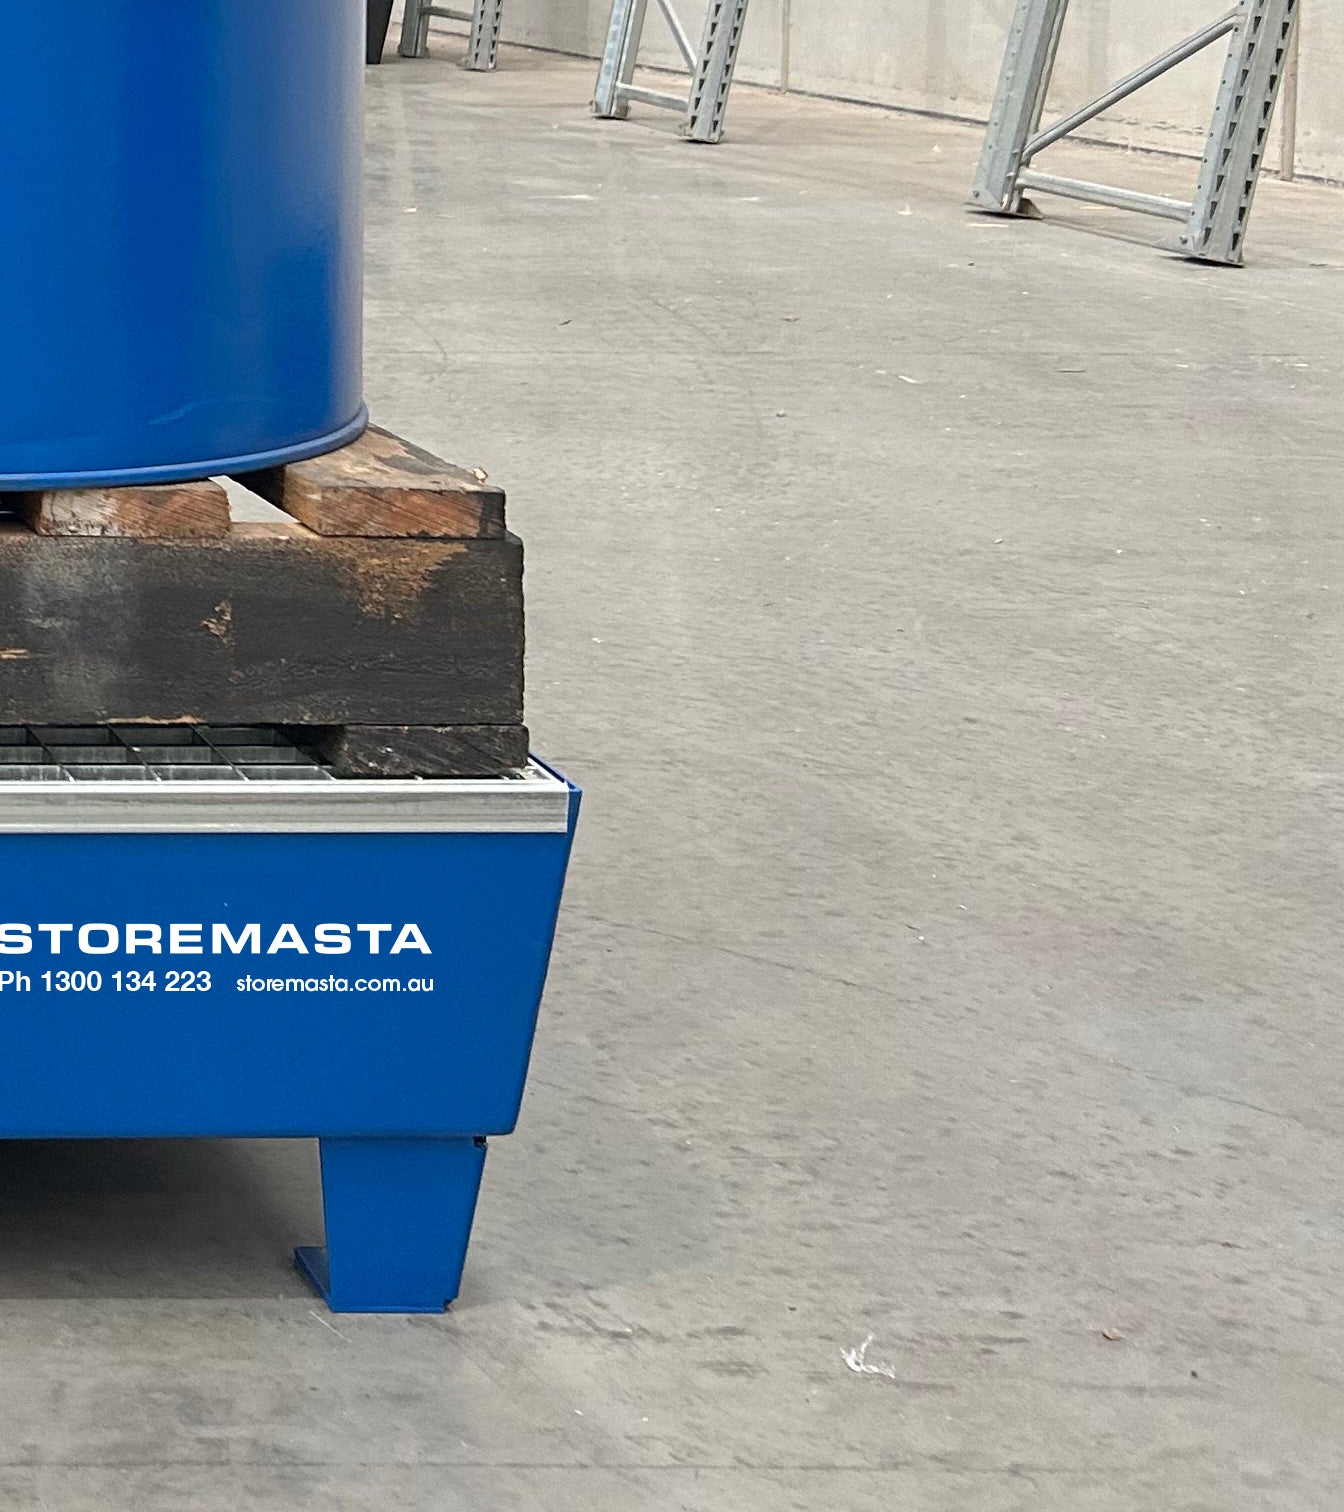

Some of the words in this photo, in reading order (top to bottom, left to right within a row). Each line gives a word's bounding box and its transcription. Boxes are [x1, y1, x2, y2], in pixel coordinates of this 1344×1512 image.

[41, 971, 102, 991] 1300
[112, 971, 156, 991] 134
[165, 971, 211, 991] 223
[237, 975, 433, 991] storemasta.com.au
